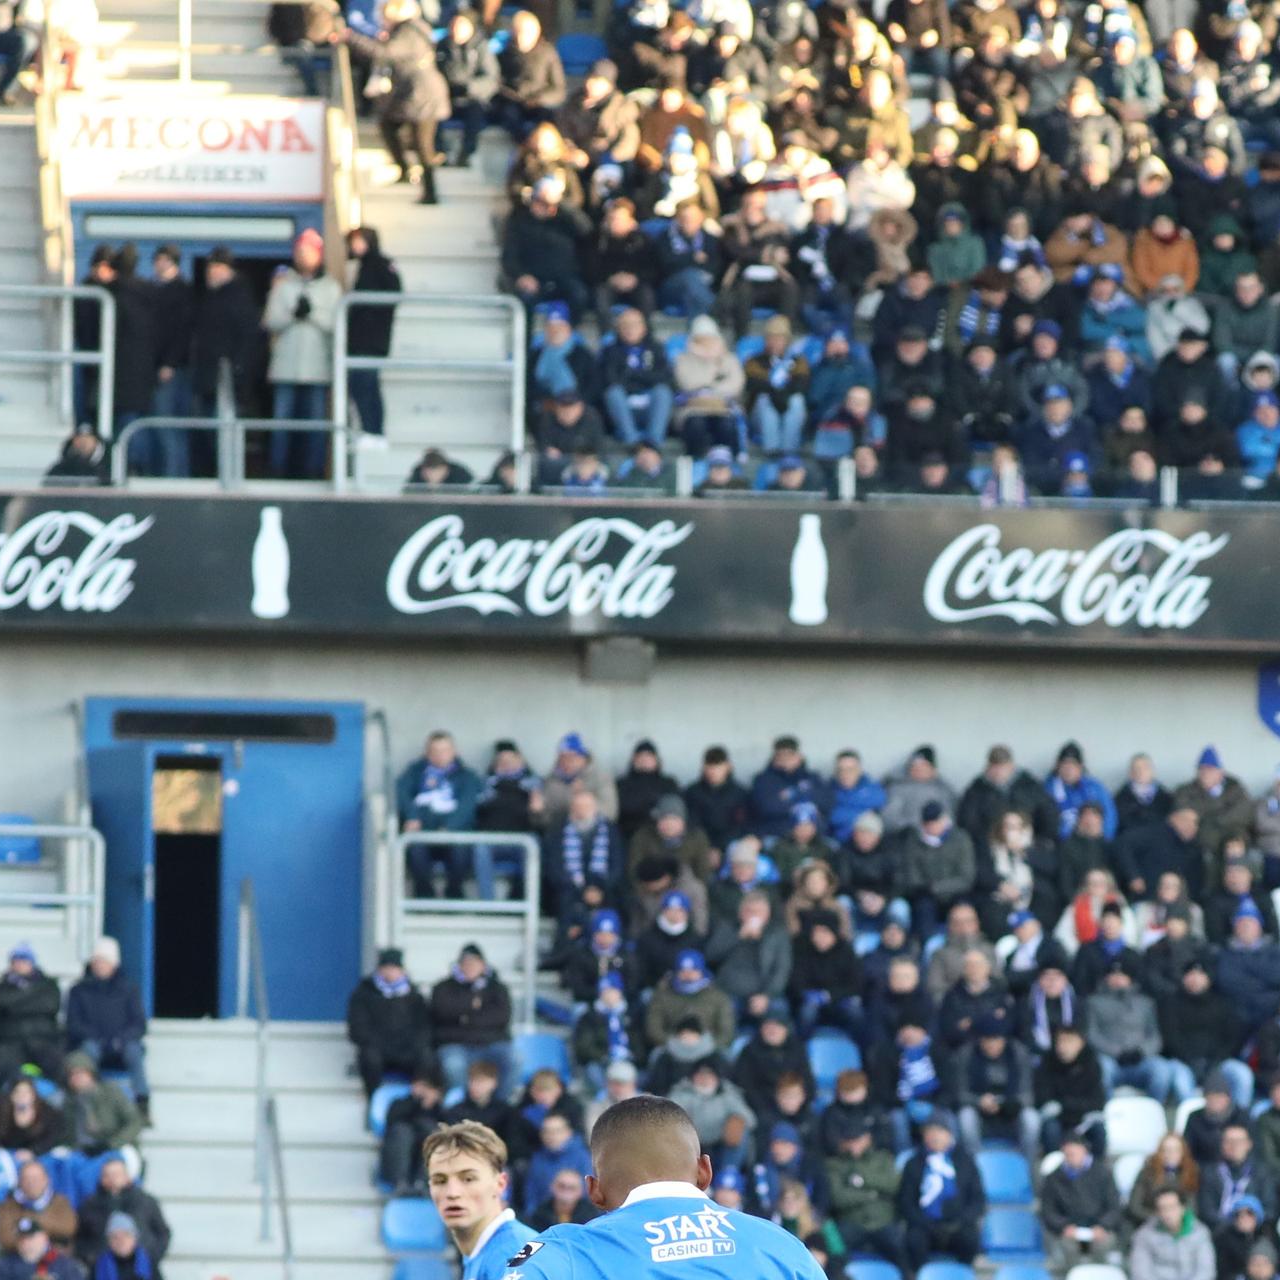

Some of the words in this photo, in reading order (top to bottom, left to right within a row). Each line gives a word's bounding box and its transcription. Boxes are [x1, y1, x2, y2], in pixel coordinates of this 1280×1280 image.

[387, 513, 695, 619] Coca-Cola
[924, 523, 1230, 630] Coca-Cola
[643, 1207, 732, 1245] STAR
[657, 1242, 708, 1258] CASINO
[714, 1241, 732, 1252] TV
